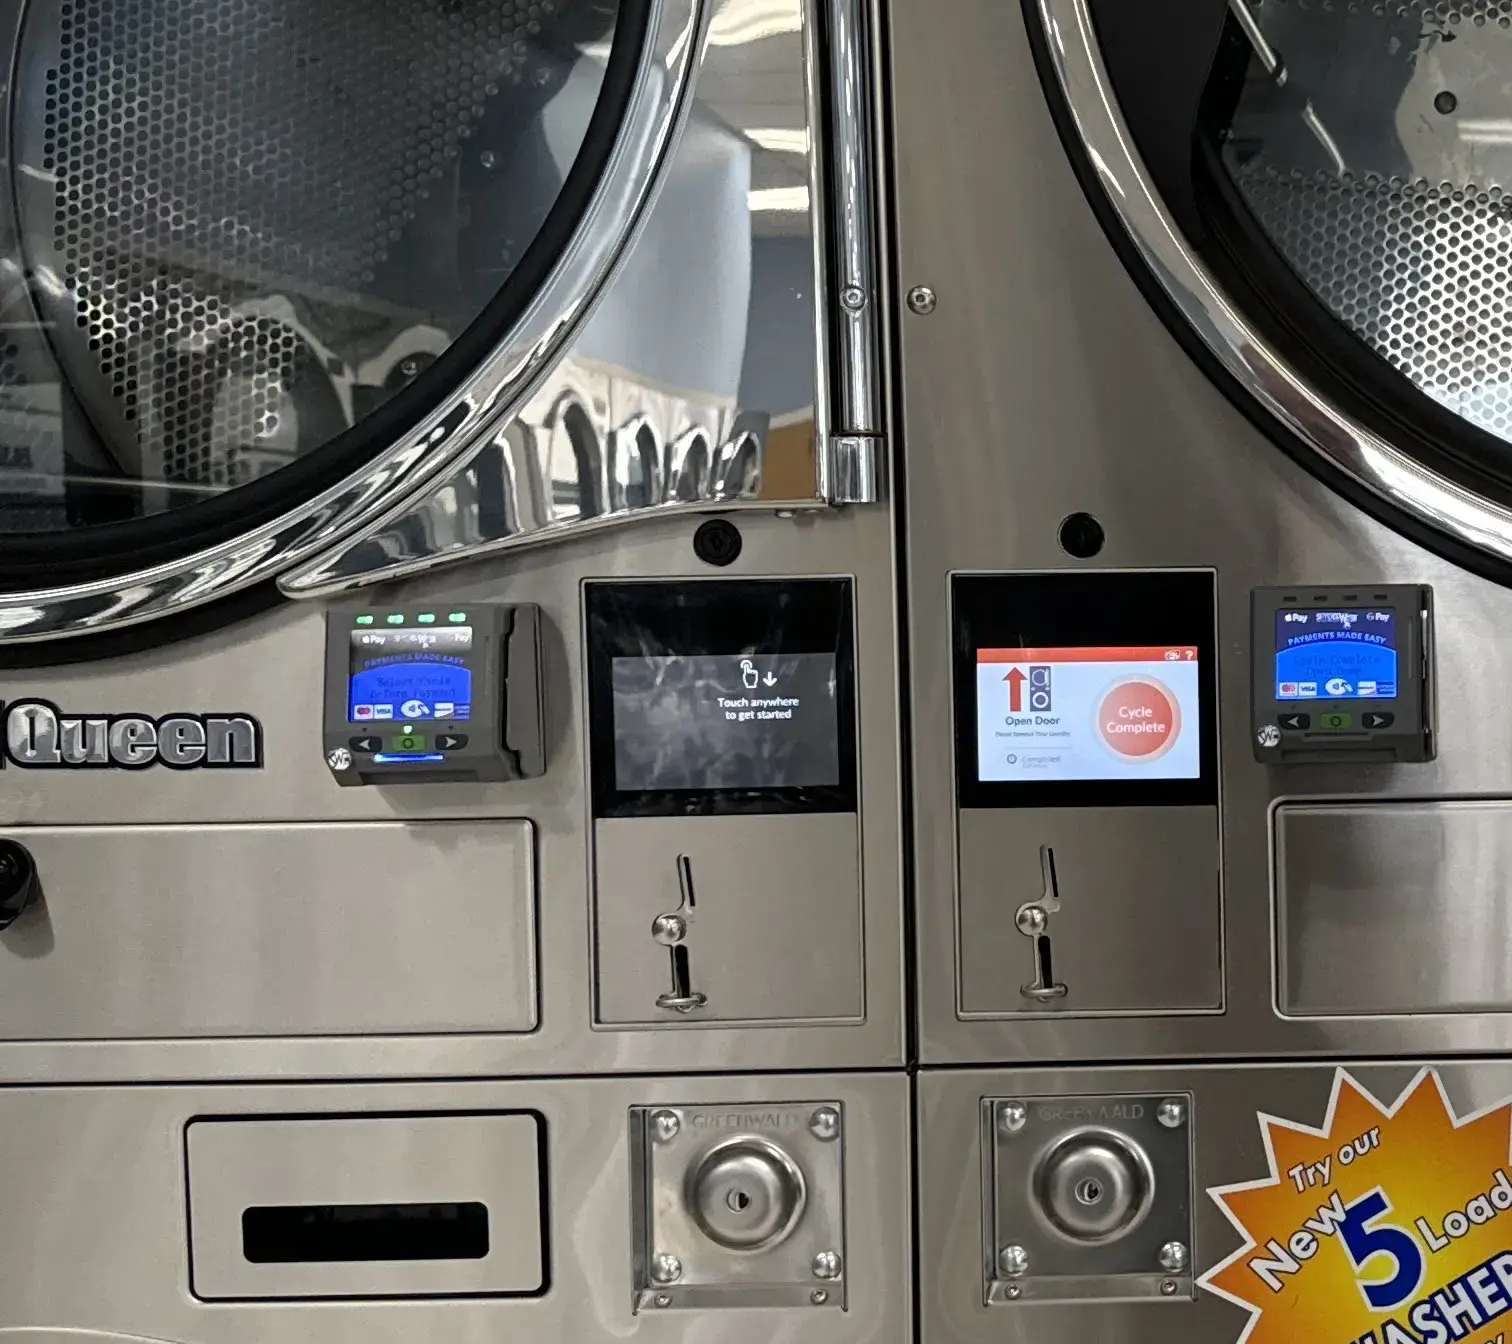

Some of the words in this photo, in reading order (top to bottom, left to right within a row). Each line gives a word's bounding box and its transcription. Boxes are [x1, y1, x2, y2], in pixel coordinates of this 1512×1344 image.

[1293, 613, 1308, 623] Pay
[1375, 612, 1390, 622] Pay
[1288, 631, 1335, 646] PAYMENTS
[1336, 631, 1362, 640] MADE
[1364, 632, 1387, 644] EASY
[717, 698, 748, 707] Touch
[751, 696, 799, 708] anywhere
[725, 710, 736, 720] to
[738, 711, 754, 721] get
[757, 709, 792, 719] started
[1118, 706, 1152, 718] Cycle
[1005, 716, 1032, 727] Open
[1035, 716, 1060, 725] Door
[1106, 721, 1165, 734] Complete
[4, 697, 264, 770] Queen
[1288, 1155, 1332, 1194] Try
[1337, 1126, 1380, 1166] our
[1246, 1190, 1349, 1294] New
[1334, 1184, 1427, 1312] 5
